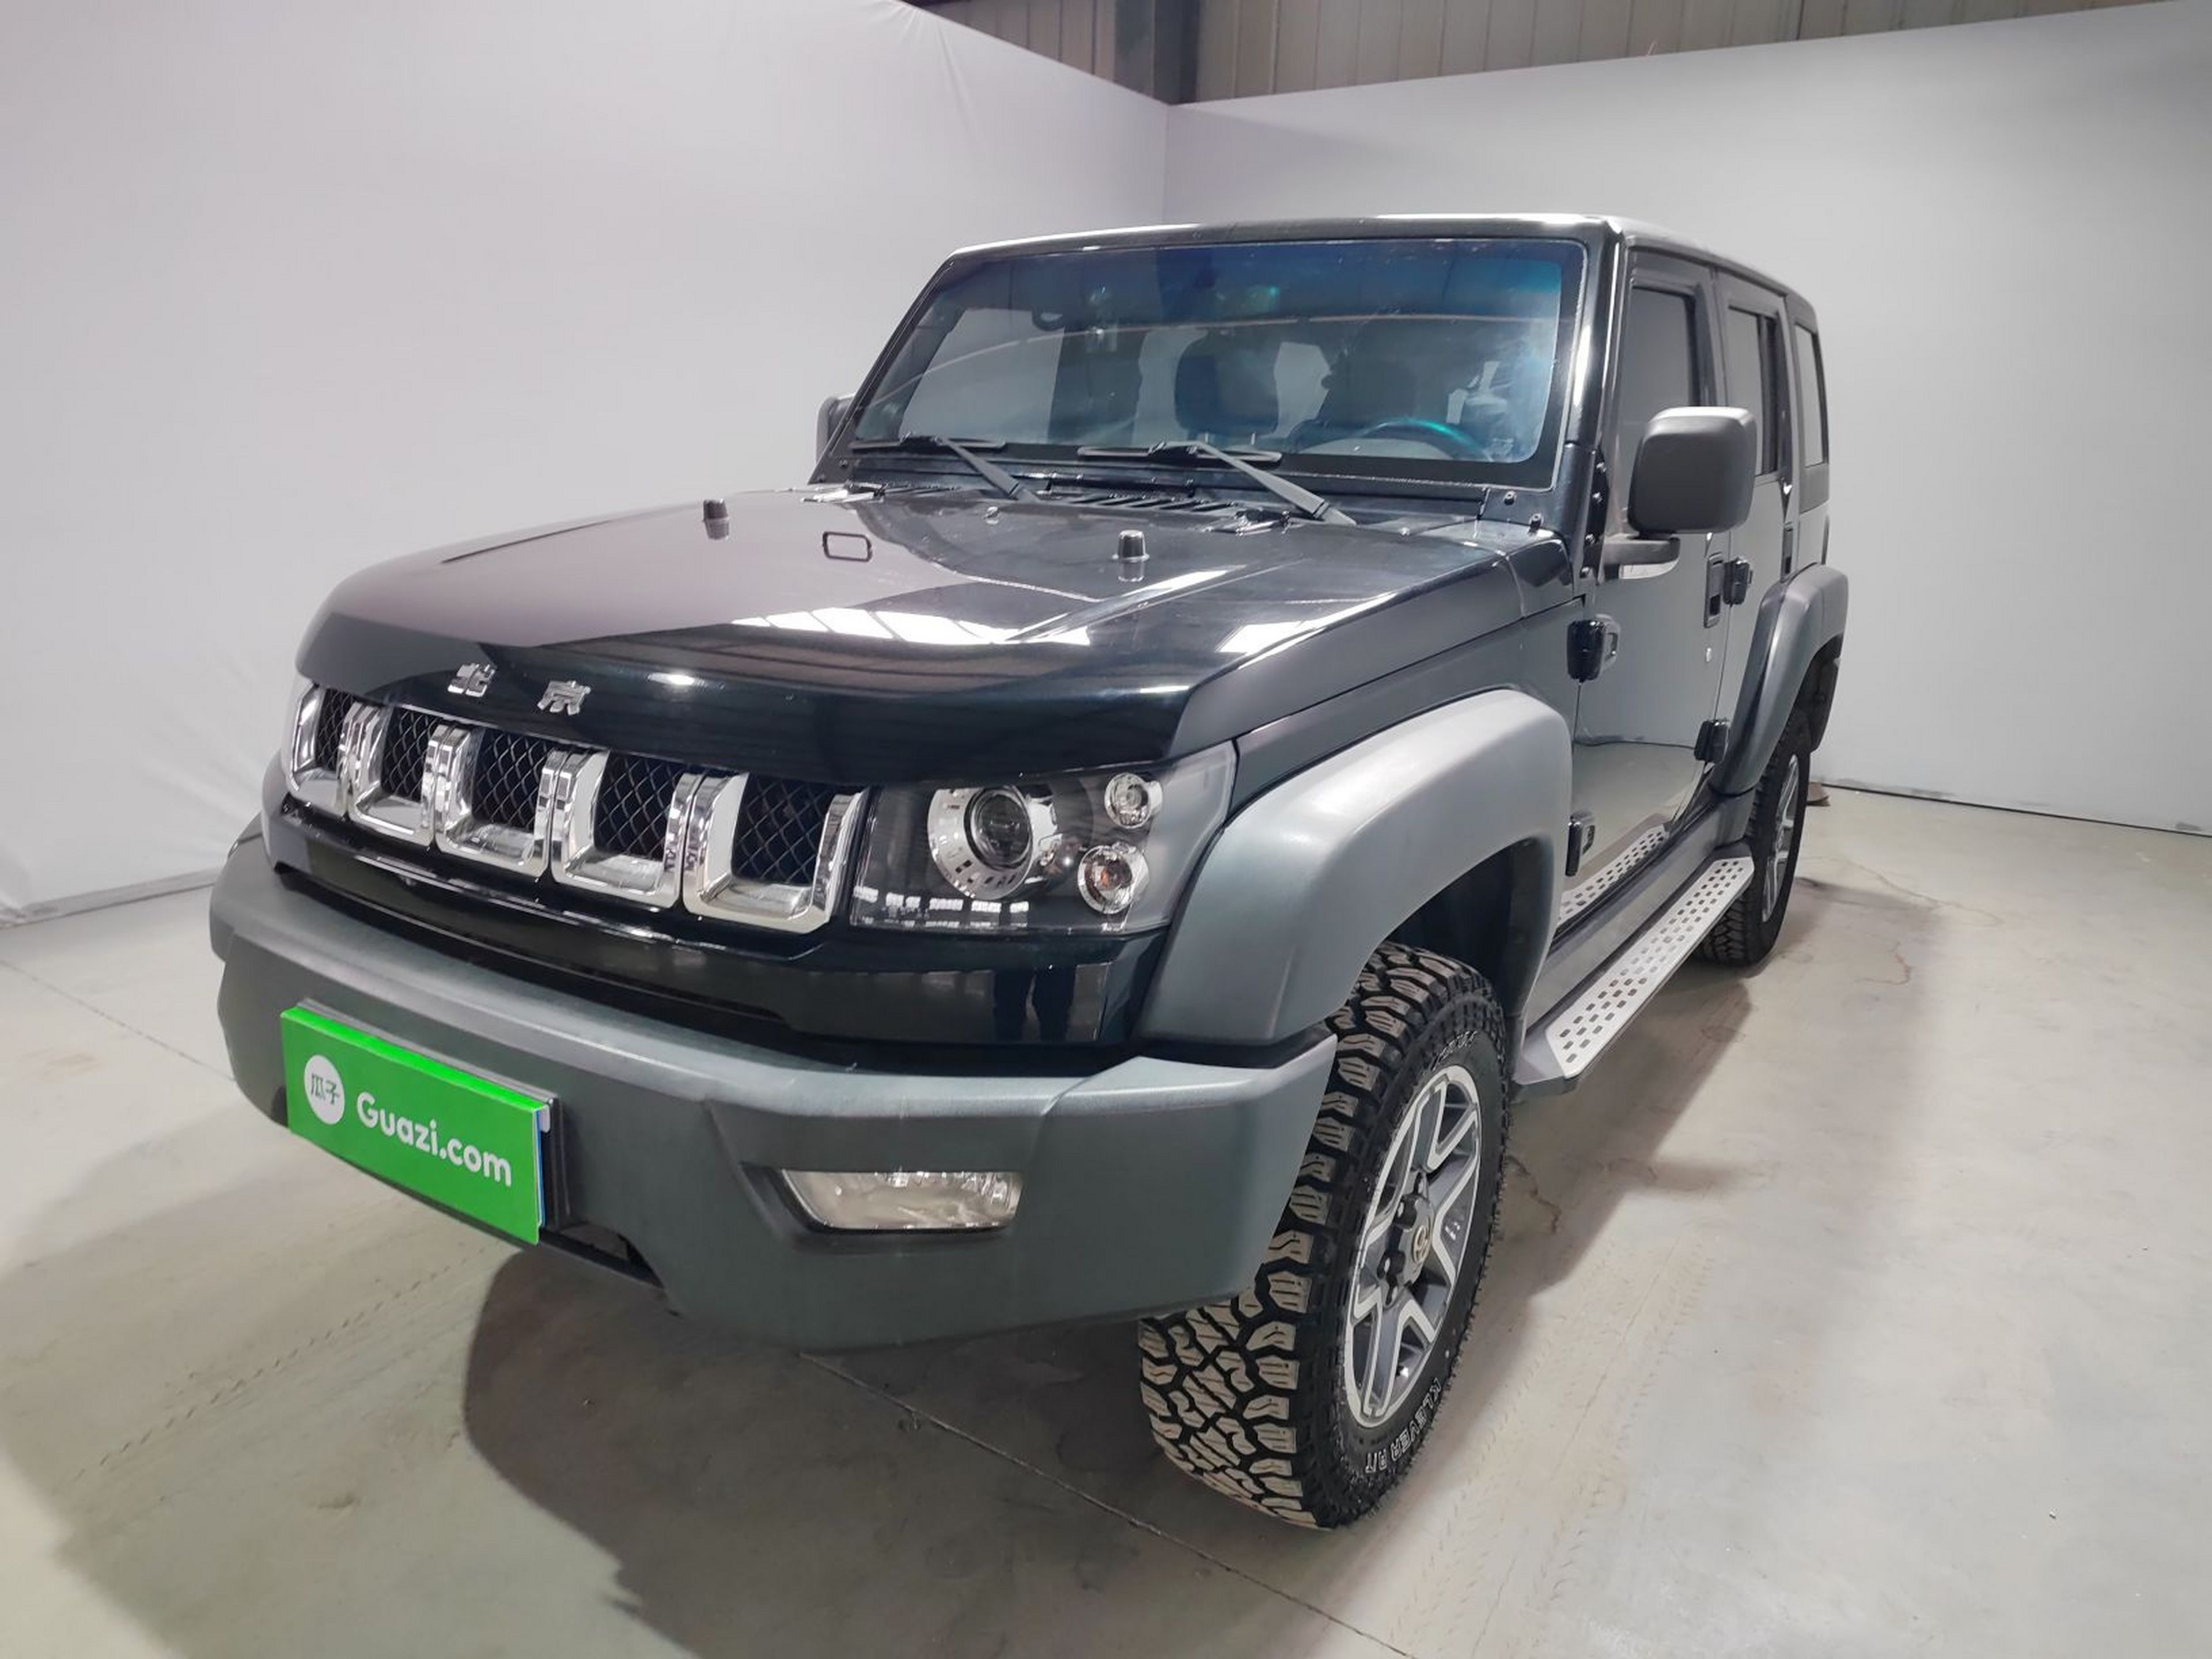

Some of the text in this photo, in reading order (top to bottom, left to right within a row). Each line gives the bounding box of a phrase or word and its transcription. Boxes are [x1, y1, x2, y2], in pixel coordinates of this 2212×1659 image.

[447, 662, 592, 715] 北京
[310, 1073, 340, 1105] 瓜子
[357, 1092, 512, 1187] Guazi.com
[1391, 1377, 1441, 1461] KLEVER
